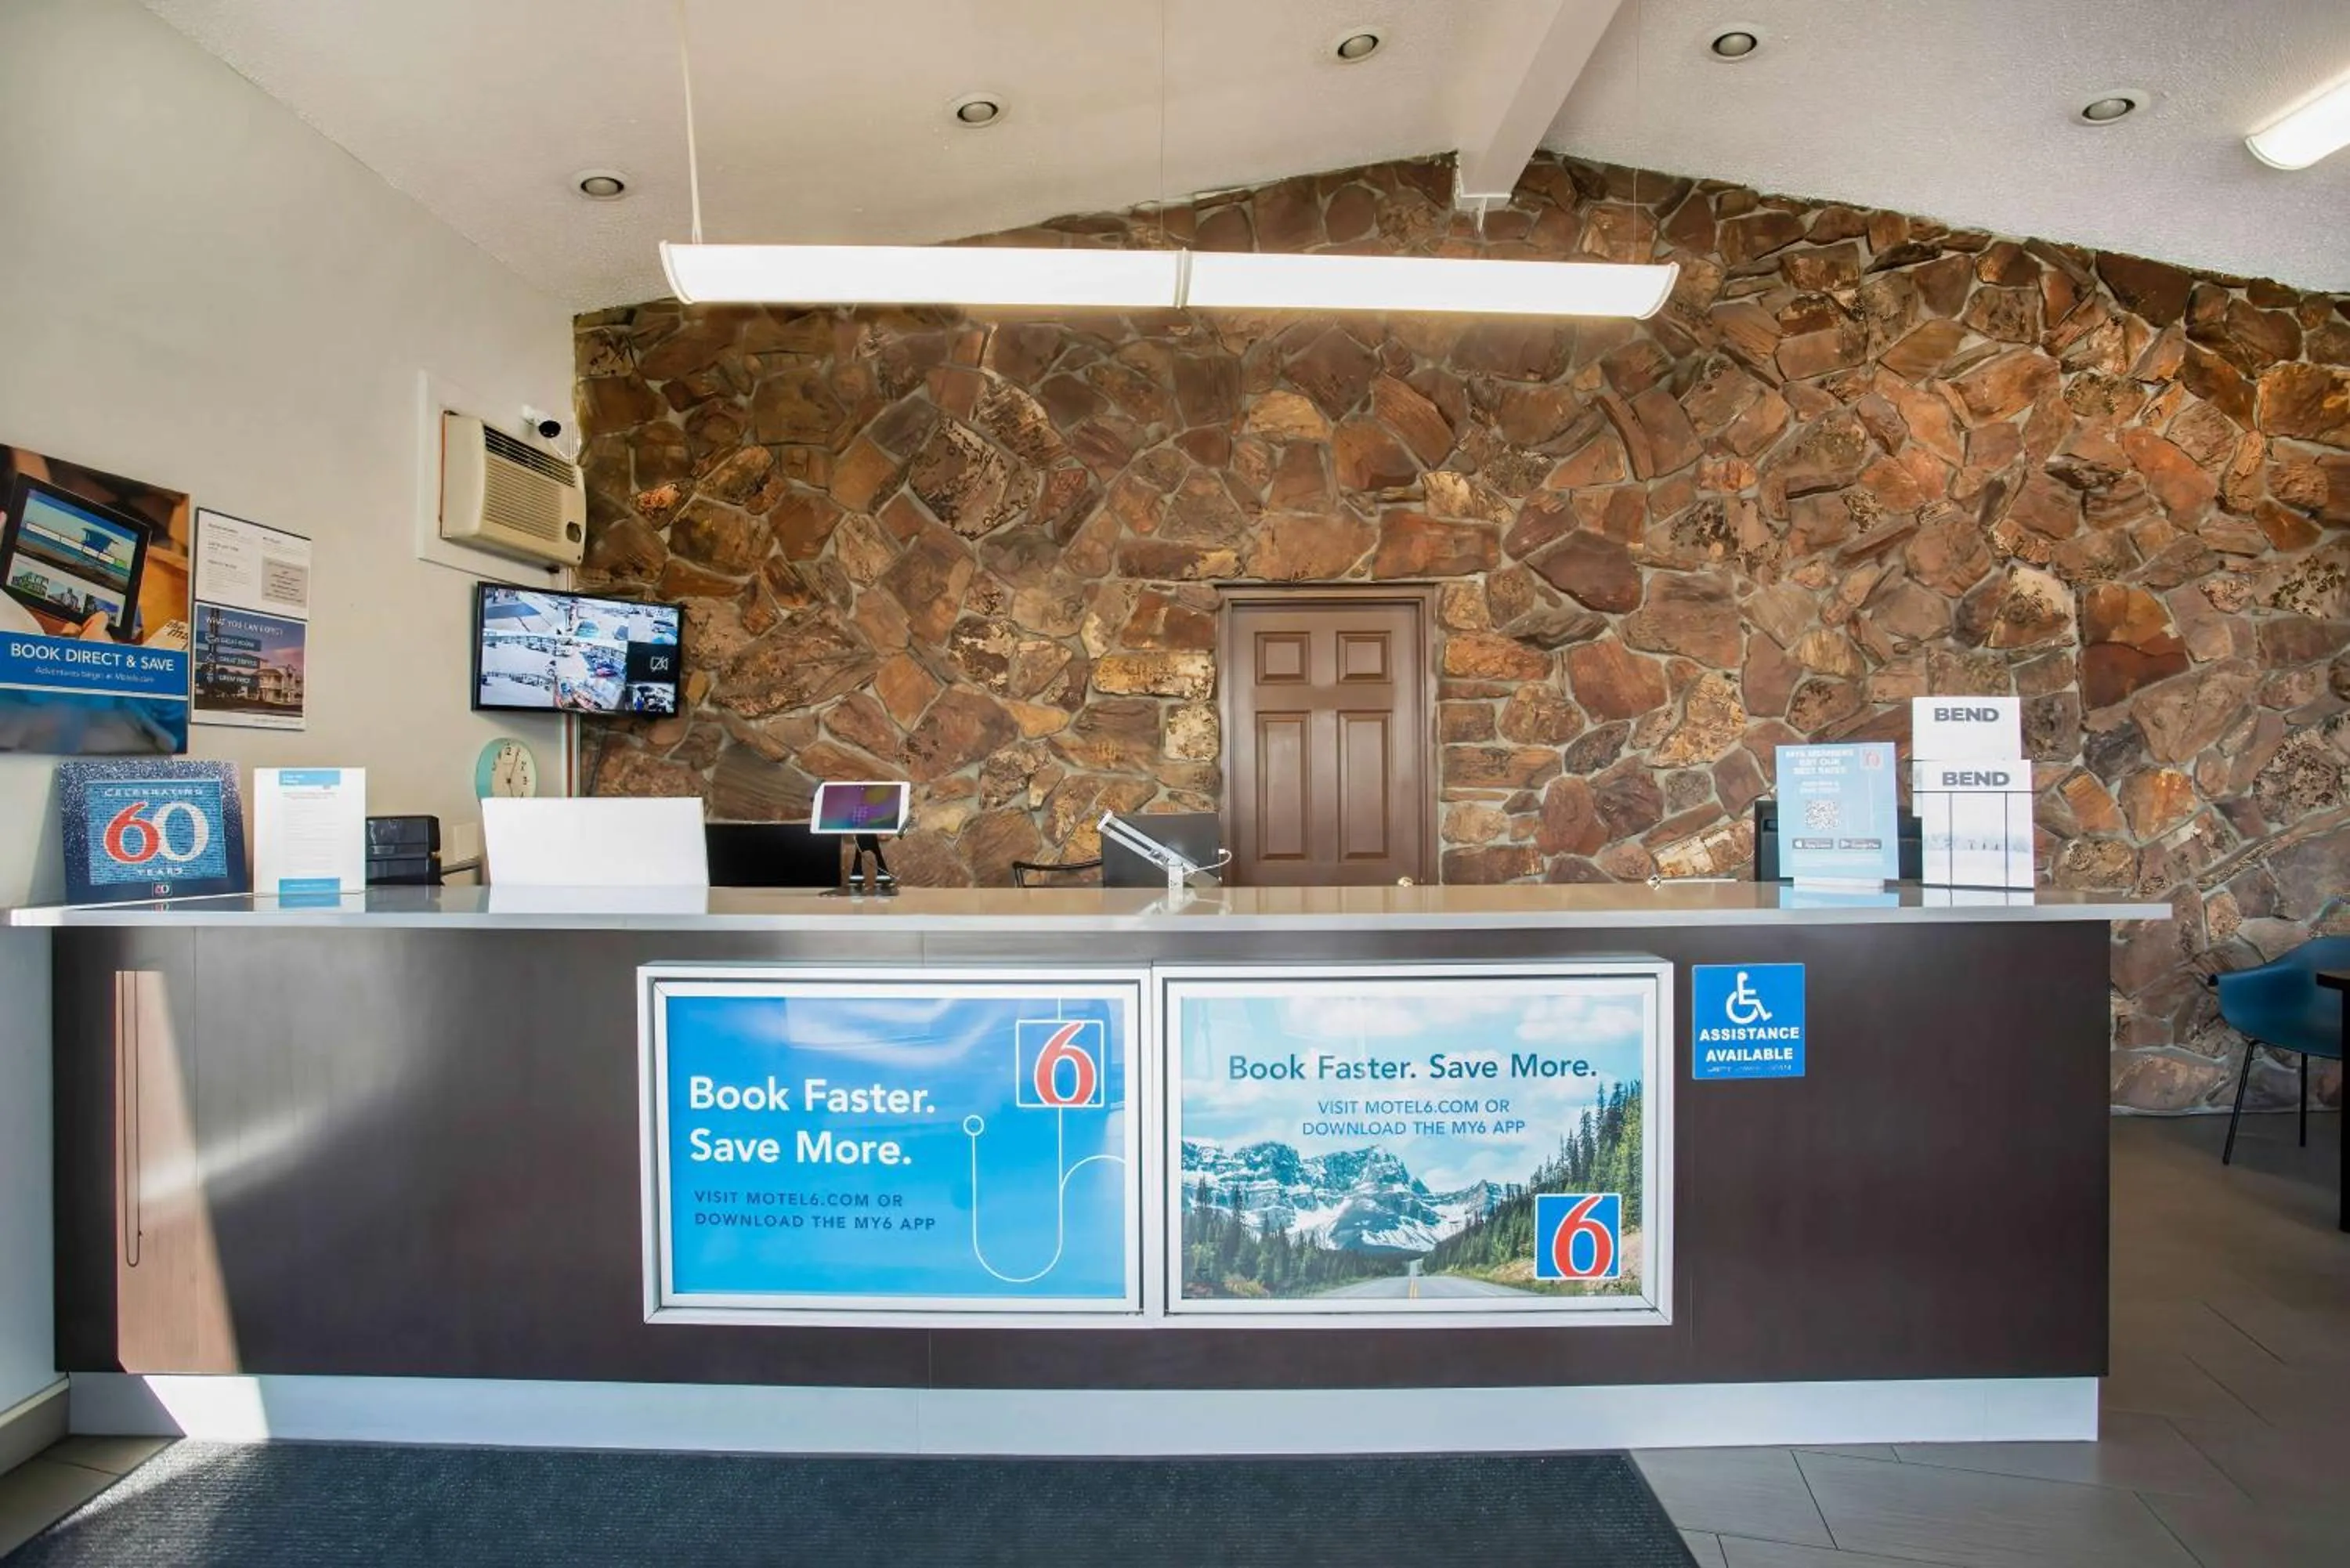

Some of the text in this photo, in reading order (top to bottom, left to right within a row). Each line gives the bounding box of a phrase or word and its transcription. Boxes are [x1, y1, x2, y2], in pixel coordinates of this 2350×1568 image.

[11, 642, 175, 671] BOOK DIRECT & SAVE
[1934, 707, 1999, 722] BEND
[1943, 771, 2010, 786] BEND
[103, 801, 209, 863] 60
[1699, 1027, 1799, 1041] ASSISTANCE
[1034, 1021, 1097, 1106] 6
[1705, 1047, 1793, 1062] AVAILABLE
[1229, 1053, 1598, 1081] Book Faster. Save More.
[689, 1076, 935, 1115] Book Faster.
[1318, 1100, 1509, 1114] VISIT MOTEL6.COM OR
[1302, 1120, 1525, 1136] DOWNLOAD THE MY6 APP
[689, 1129, 913, 1165] Save More.
[694, 1190, 903, 1208] VISIT MOTEL6.COM OR
[695, 1213, 935, 1231] DOWNLOAD THE MY6 APP
[1553, 1195, 1614, 1279] 6
